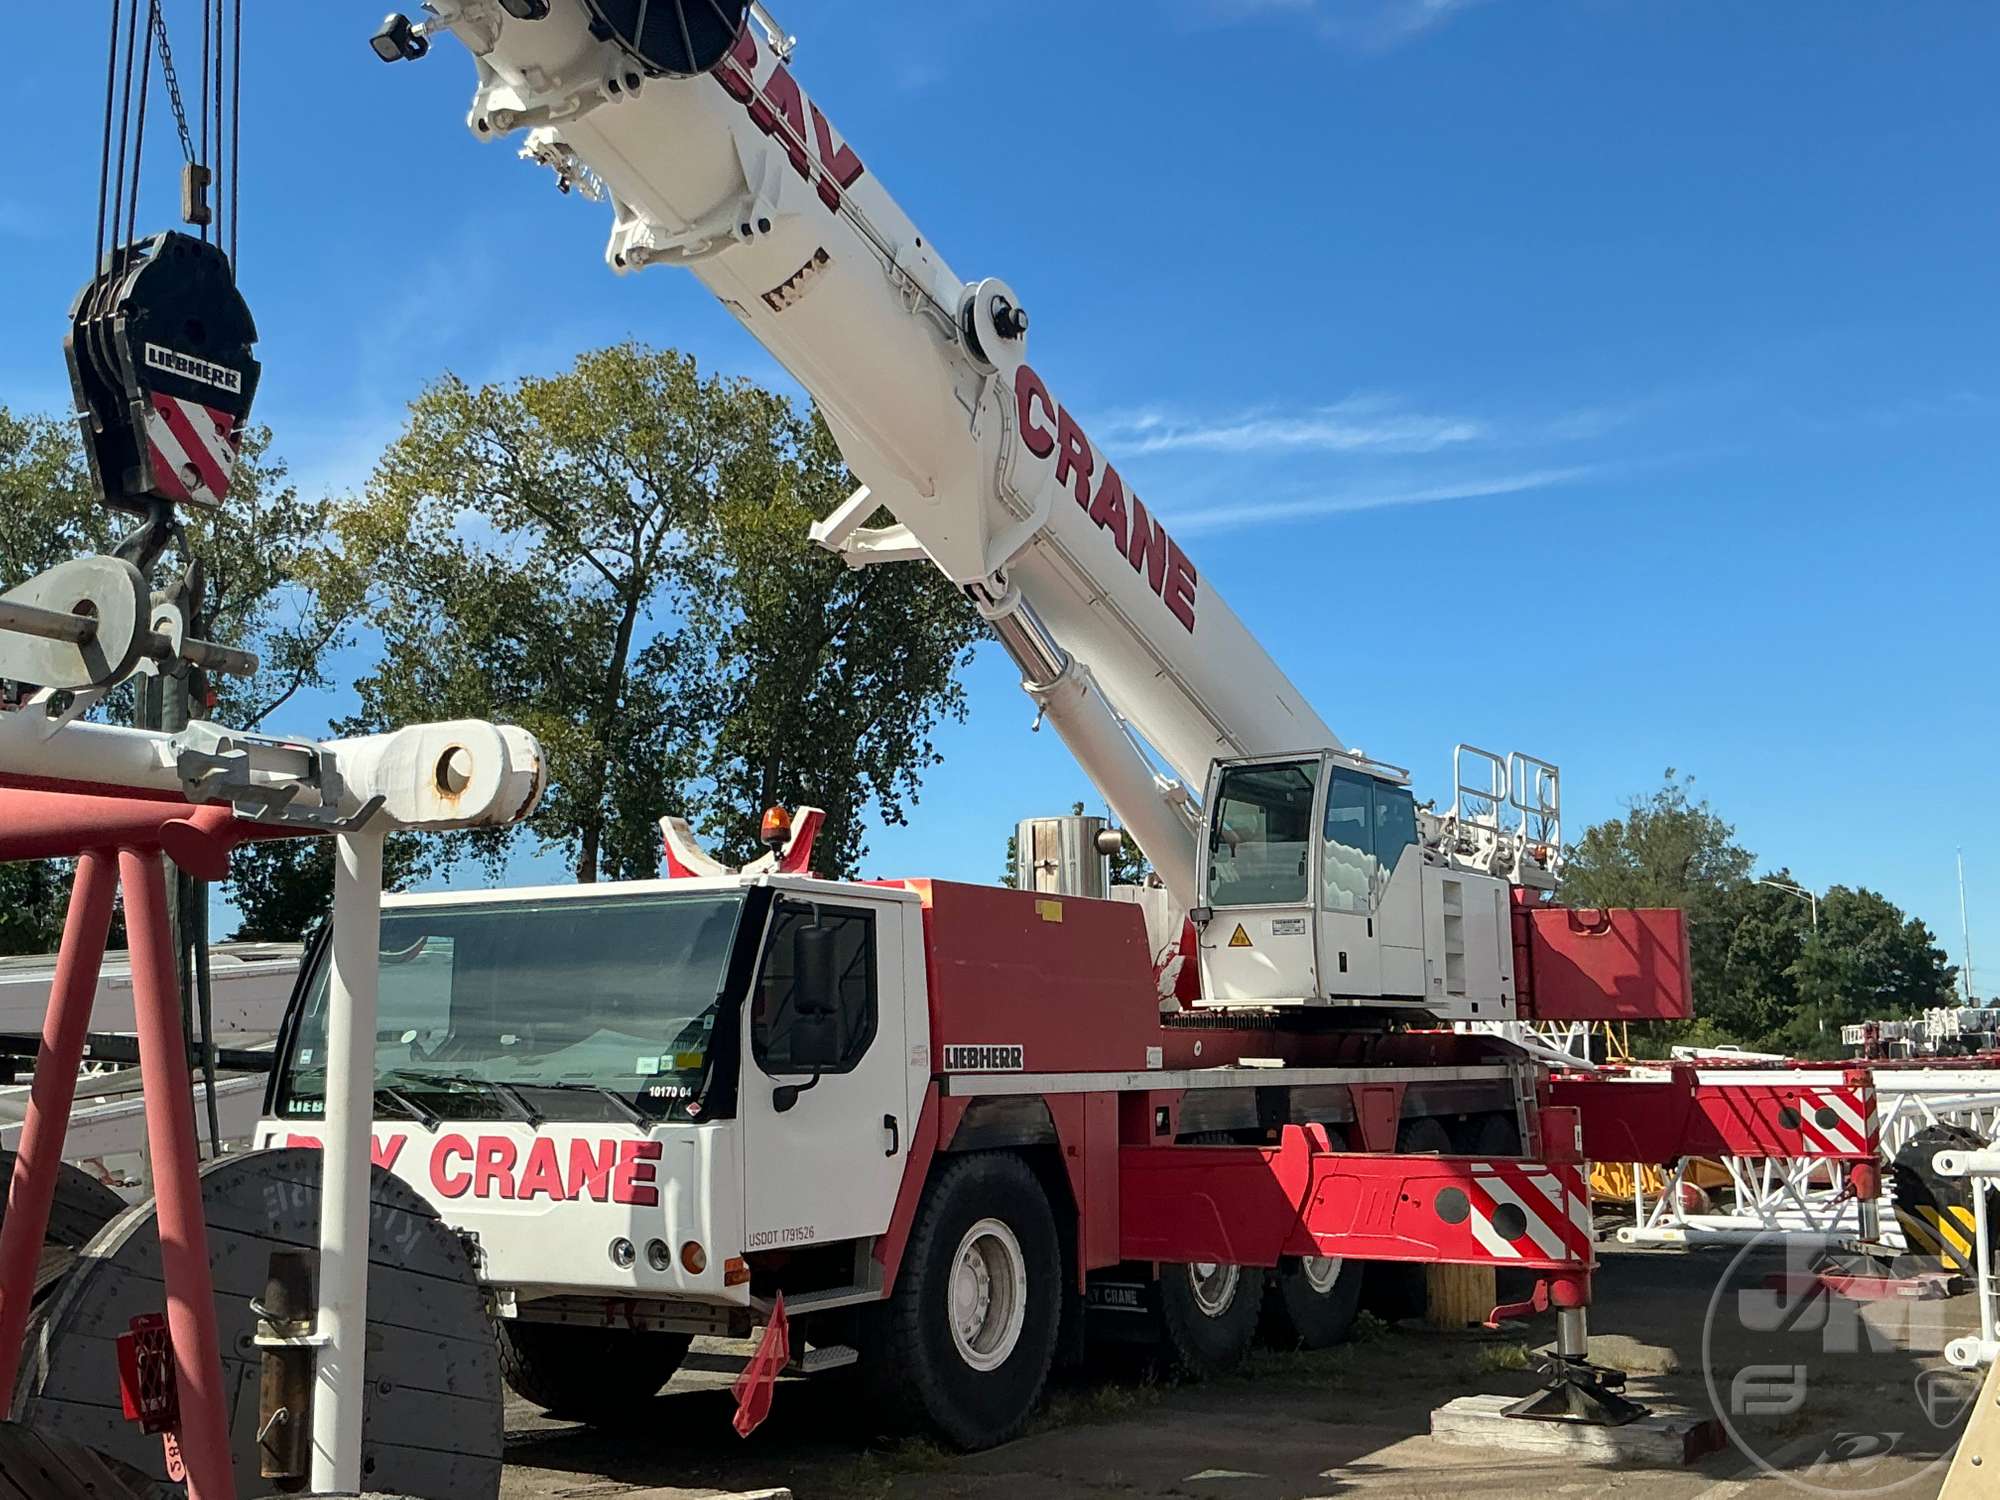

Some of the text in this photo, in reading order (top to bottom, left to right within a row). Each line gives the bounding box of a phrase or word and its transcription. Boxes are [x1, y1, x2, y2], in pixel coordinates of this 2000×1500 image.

[148, 348, 238, 389] LIEBHERR
[1014, 364, 1198, 634] CRANE
[944, 1046, 1022, 1069] LIEBHERR
[288, 1099, 327, 1112] LIEB
[429, 1133, 663, 1207] CRANE
[749, 1224, 815, 1247] USDOT 1791526
[1104, 1287, 1138, 1305] CRANE
